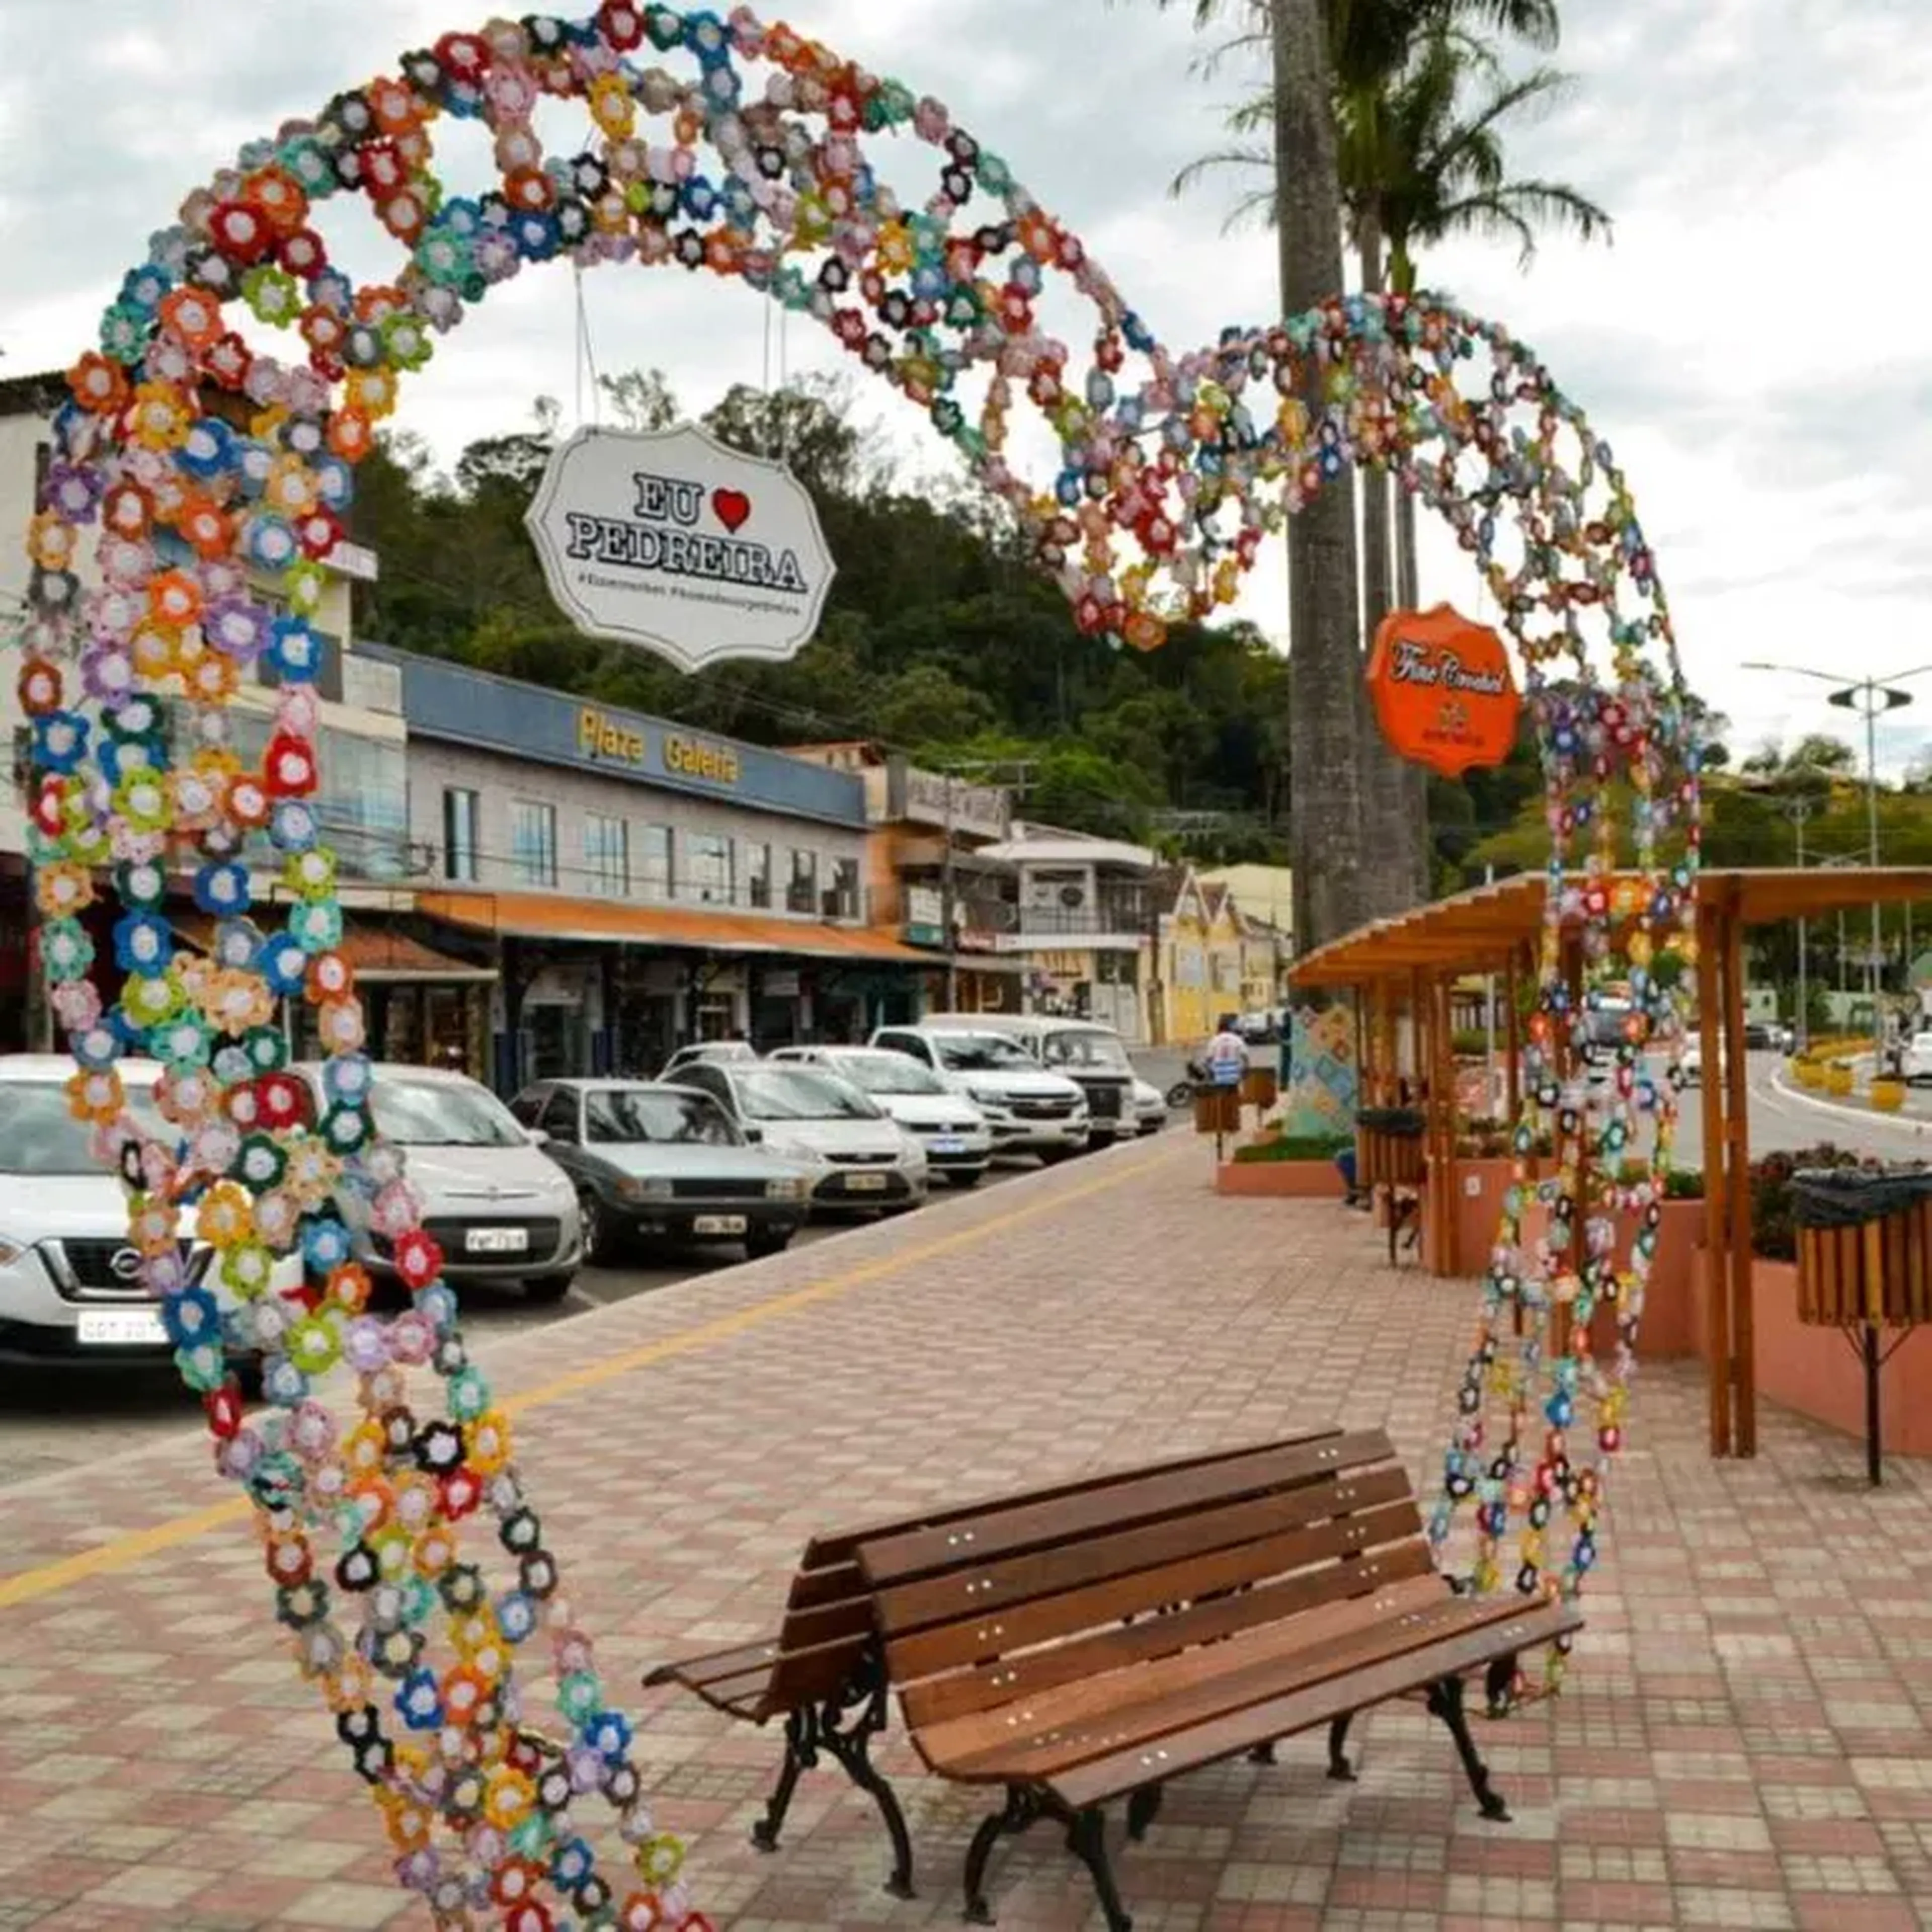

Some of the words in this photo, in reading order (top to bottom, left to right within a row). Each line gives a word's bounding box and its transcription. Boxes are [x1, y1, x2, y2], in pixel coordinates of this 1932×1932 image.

[633, 473, 705, 526] EU
[566, 512, 808, 594] PEDREIRA
[579, 705, 645, 760] Plaza
[665, 732, 739, 784] Galeria
